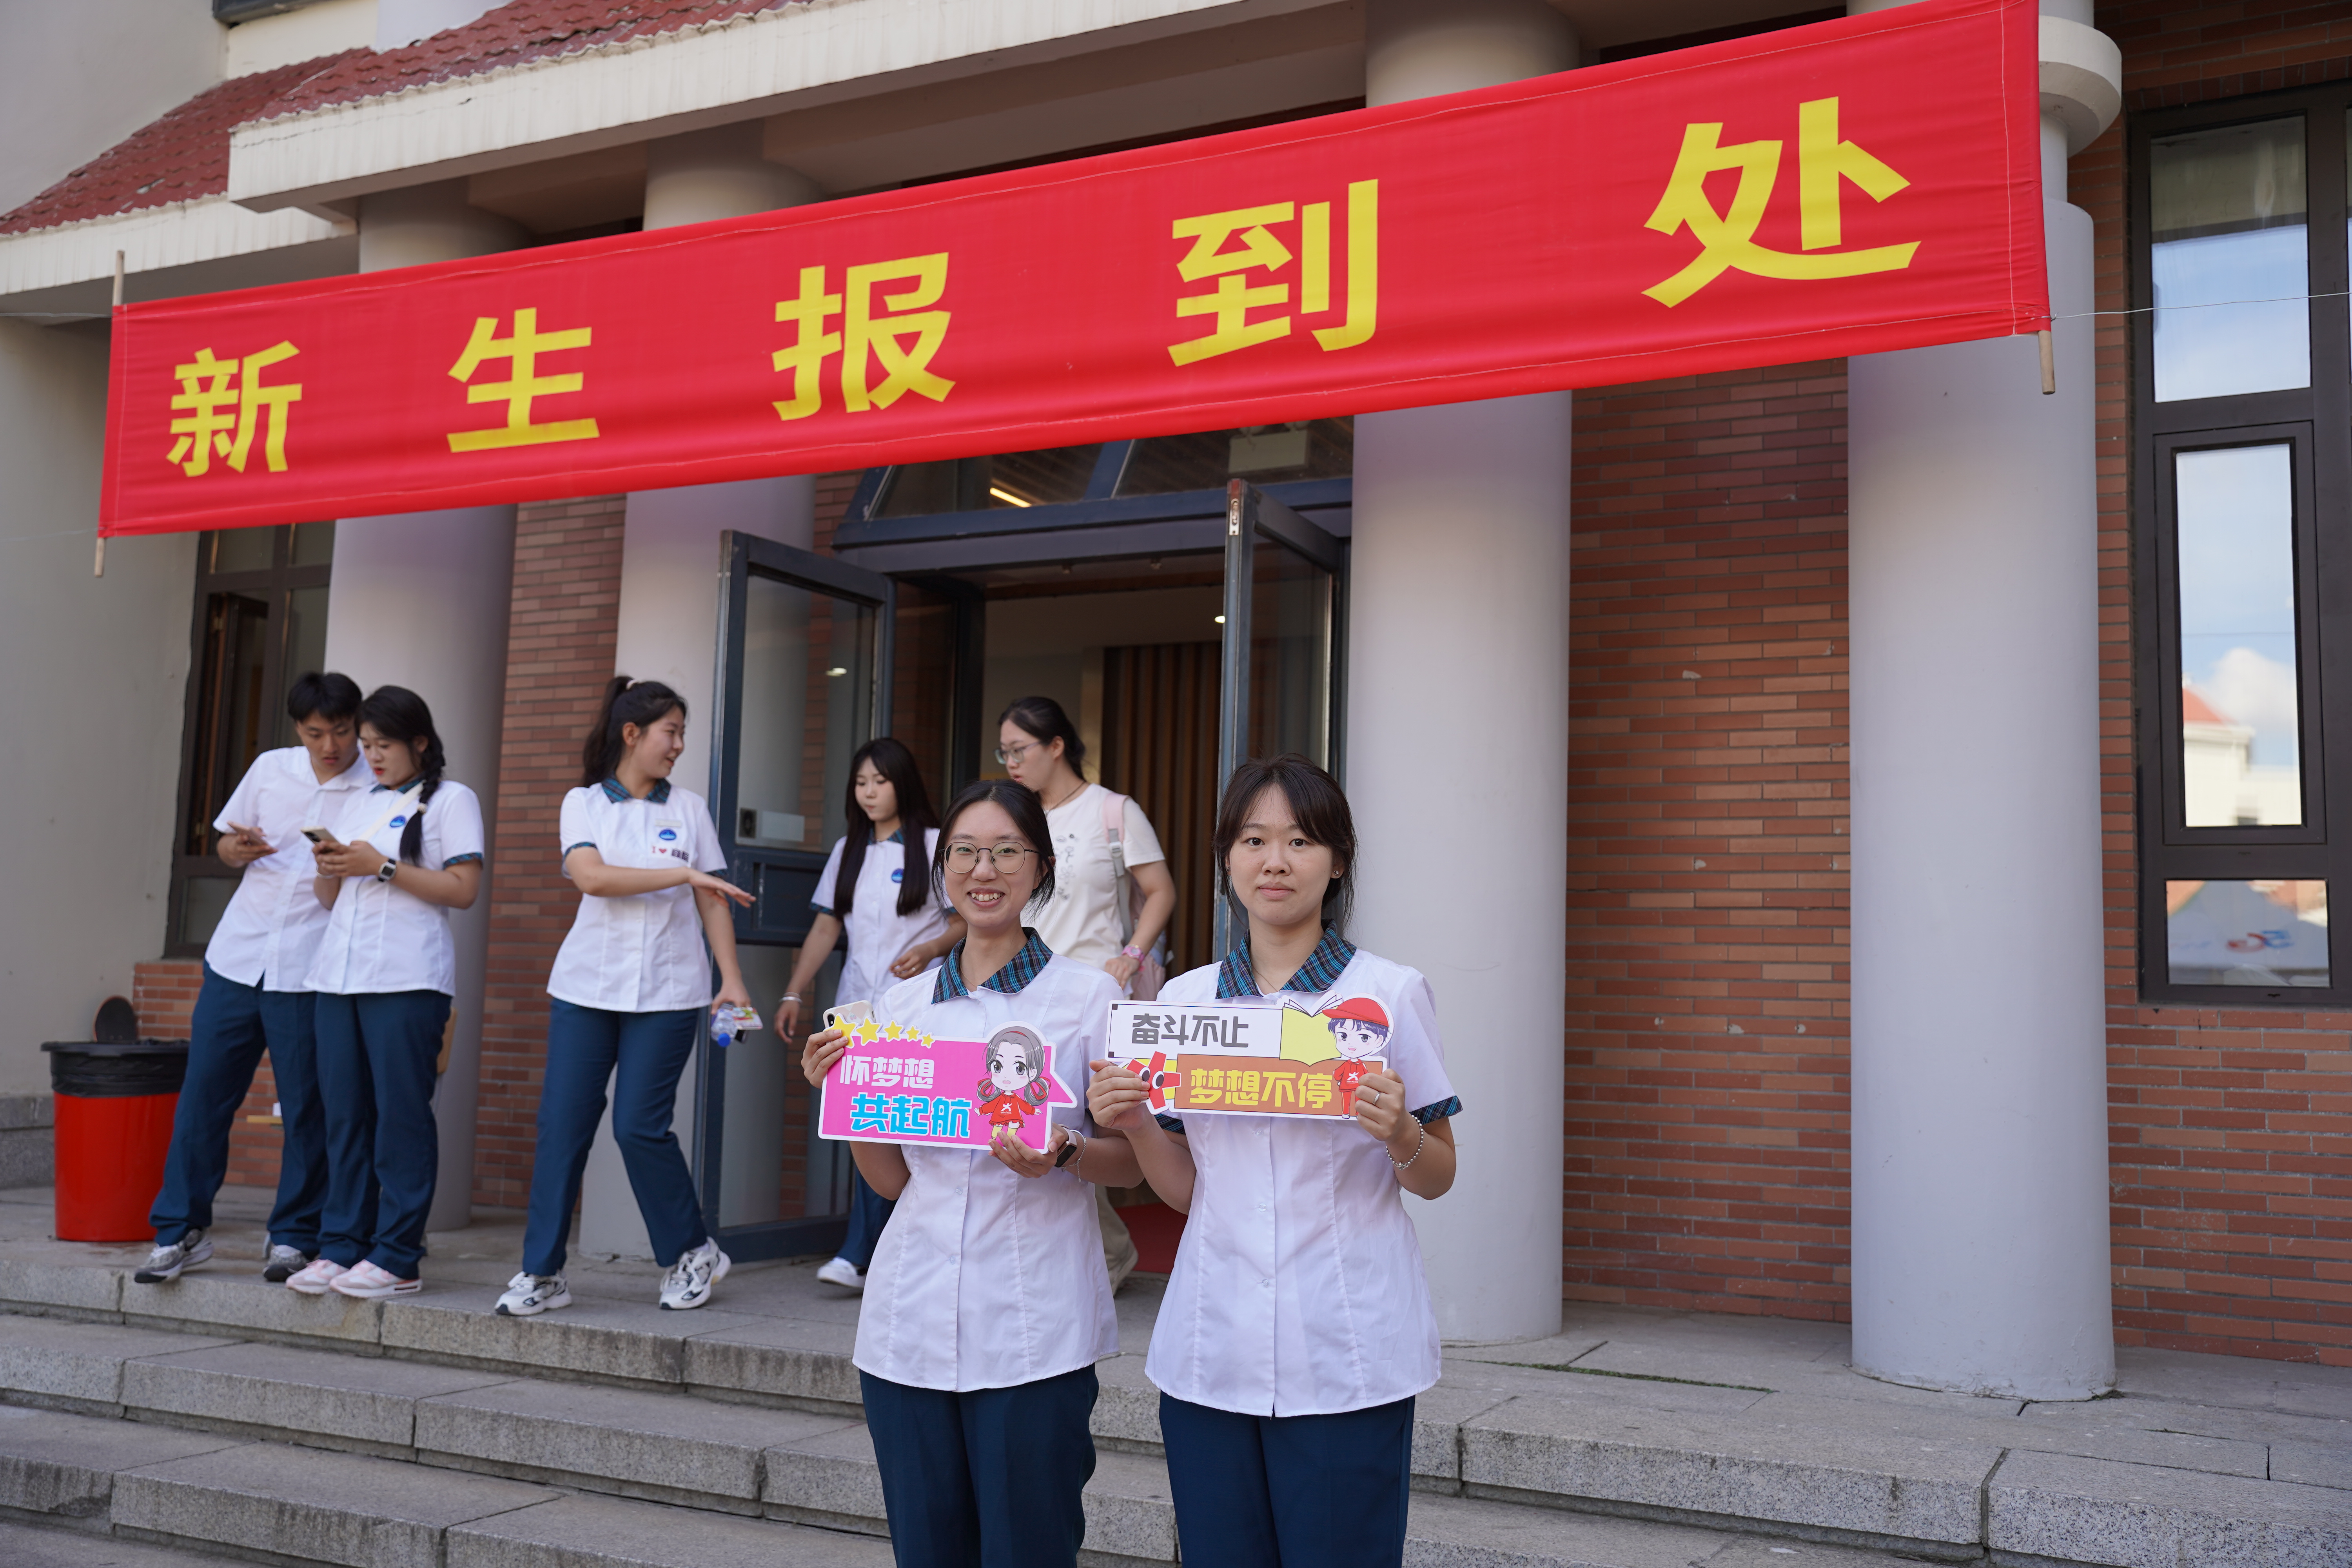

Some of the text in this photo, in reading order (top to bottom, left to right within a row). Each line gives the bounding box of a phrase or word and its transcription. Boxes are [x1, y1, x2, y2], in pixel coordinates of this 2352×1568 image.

[168, 97, 1920, 475] 新生报到处
[1132, 1013, 1249, 1048] 奋斗不止
[840, 1055, 935, 1089] 怀梦想
[1189, 1068, 1333, 1109] 梦想不停
[850, 1092, 972, 1138] 共起航
